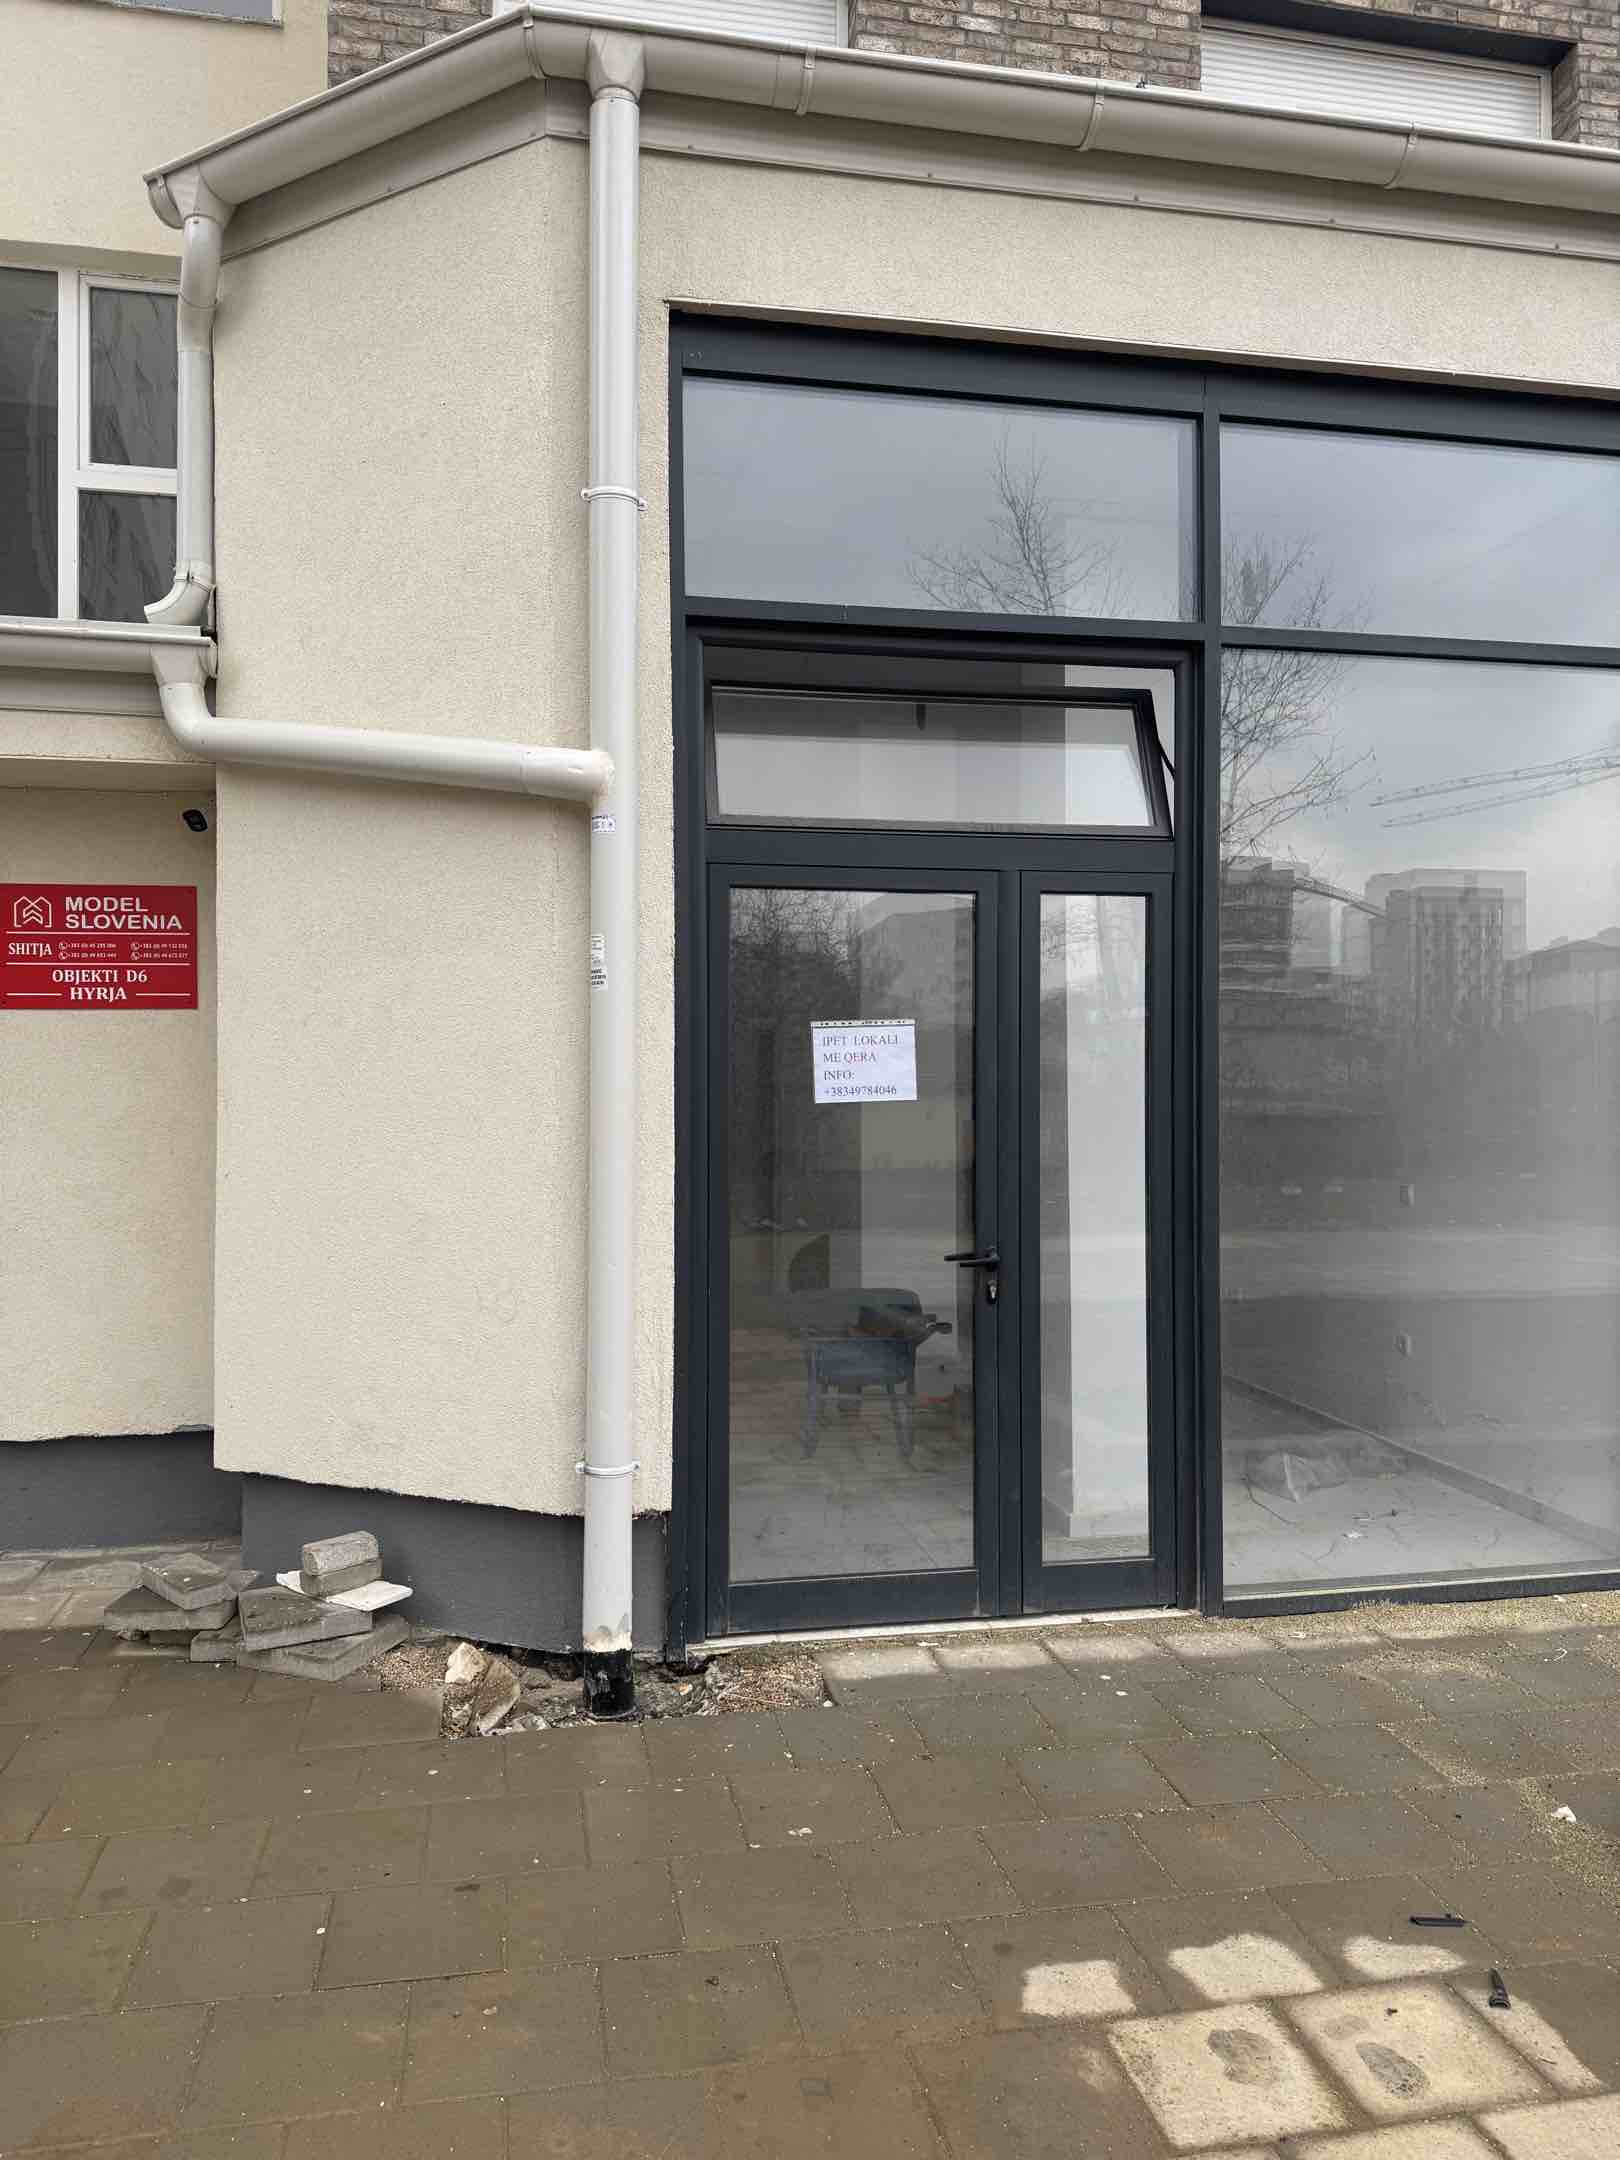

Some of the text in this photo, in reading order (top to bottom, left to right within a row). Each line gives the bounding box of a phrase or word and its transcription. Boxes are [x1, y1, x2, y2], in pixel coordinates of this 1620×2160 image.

[65, 896, 149, 912] MODEL
[65, 914, 183, 930] SLOVENIA
[8, 942, 53, 957] SHITJA
[52, 969, 148, 985] OBJEKTI D6
[70, 986, 128, 1003] HYRJA
[854, 1034, 899, 1046] LOKALI
[823, 1053, 841, 1063] ME
[824, 1070, 856, 1081] INFO:
